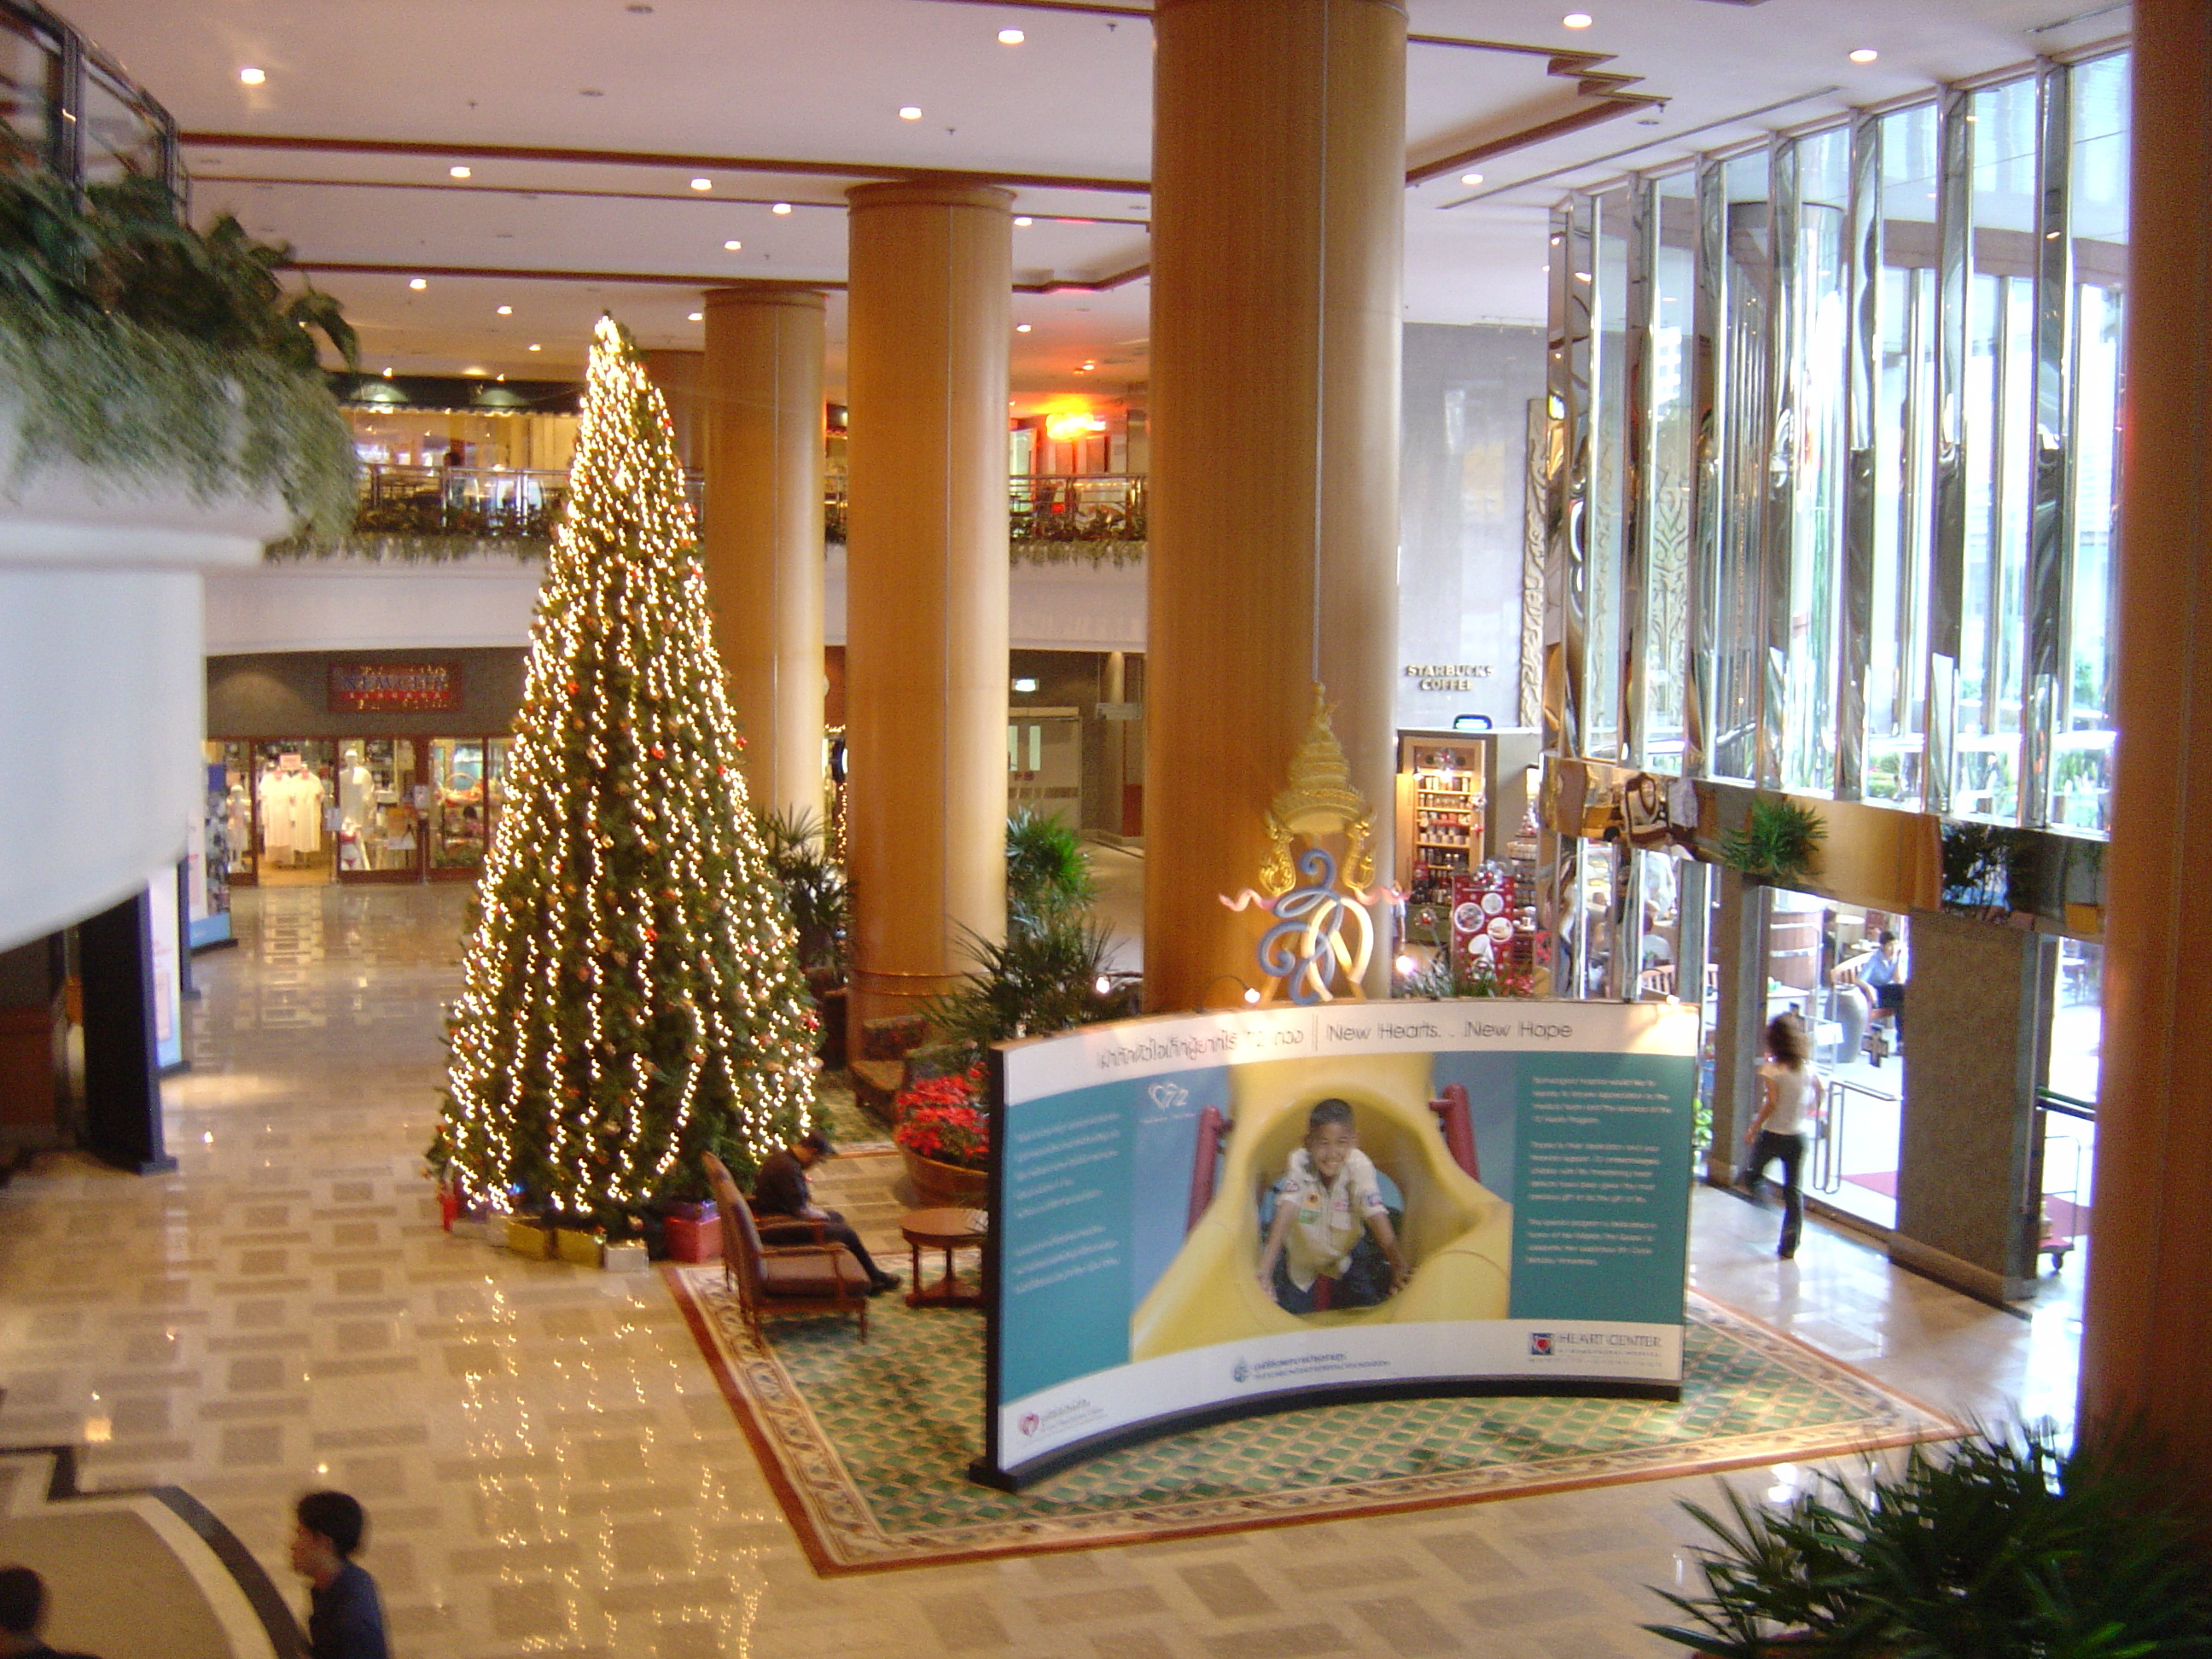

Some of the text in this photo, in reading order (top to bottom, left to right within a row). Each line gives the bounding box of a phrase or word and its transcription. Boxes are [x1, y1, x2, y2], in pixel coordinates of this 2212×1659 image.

[1405, 665, 1494, 678] STARBUCKS
[1419, 678, 1475, 691] COFFEE
[1326, 1023, 1371, 1042] New
[1464, 1021, 1511, 1038] New
[1517, 1020, 1573, 1041] Hope
[1559, 1332, 1662, 1348] HEART CENTER
